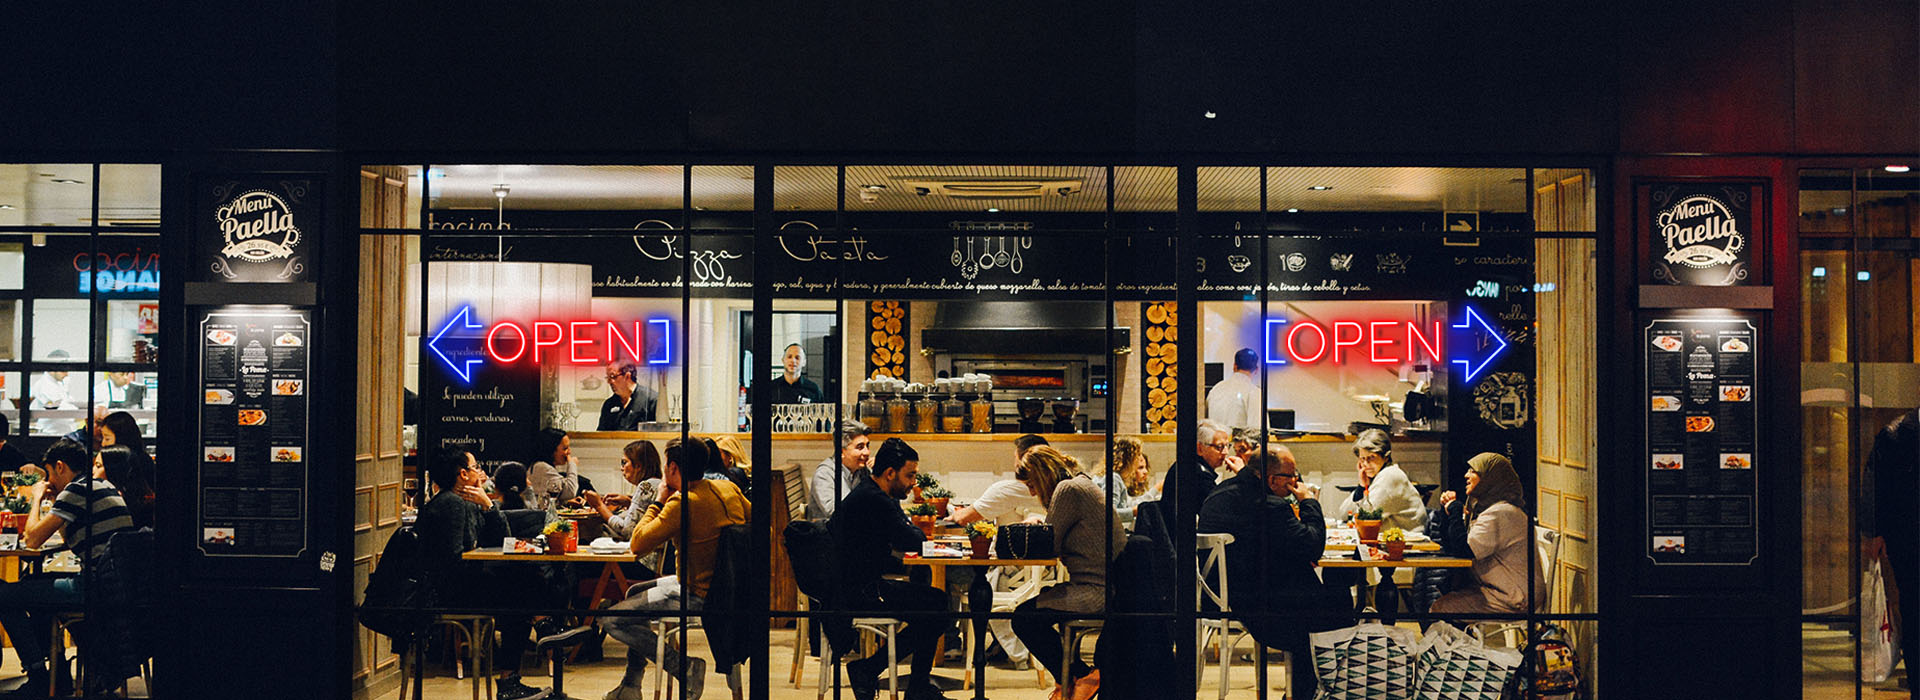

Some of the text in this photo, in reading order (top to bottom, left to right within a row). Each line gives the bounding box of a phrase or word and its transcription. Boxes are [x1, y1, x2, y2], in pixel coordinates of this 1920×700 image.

[220, 210, 295, 243] Paella
[779, 220, 889, 262] Pasta
[1661, 215, 1738, 249] Paella
[633, 219, 743, 281] Pizza
[606, 275, 660, 288] habitualmente
[660, 280, 671, 288] es
[725, 275, 754, 288] harina
[789, 276, 803, 289] sal,
[805, 282, 824, 293] agua
[826, 283, 833, 293] y
[872, 283, 879, 294] y
[880, 277, 931, 294] generalmente
[931, 278, 964, 290] cubierto
[964, 282, 975, 290] de
[976, 284, 998, 294] queso
[1000, 278, 1046, 295] mozzarella,
[1047, 279, 1068, 290] salsa
[1279, 281, 1301, 292] tiras
[1301, 281, 1312, 292] de
[1313, 279, 1343, 292] cebolla
[1342, 284, 1349, 295] y
[487, 320, 641, 363] OPEN
[1287, 320, 1441, 363] OPEN
[453, 390, 483, 408] pueden
[484, 385, 514, 408] utilizar
[441, 412, 514, 423] carnes, verduras,
[441, 434, 486, 452] pescados y
